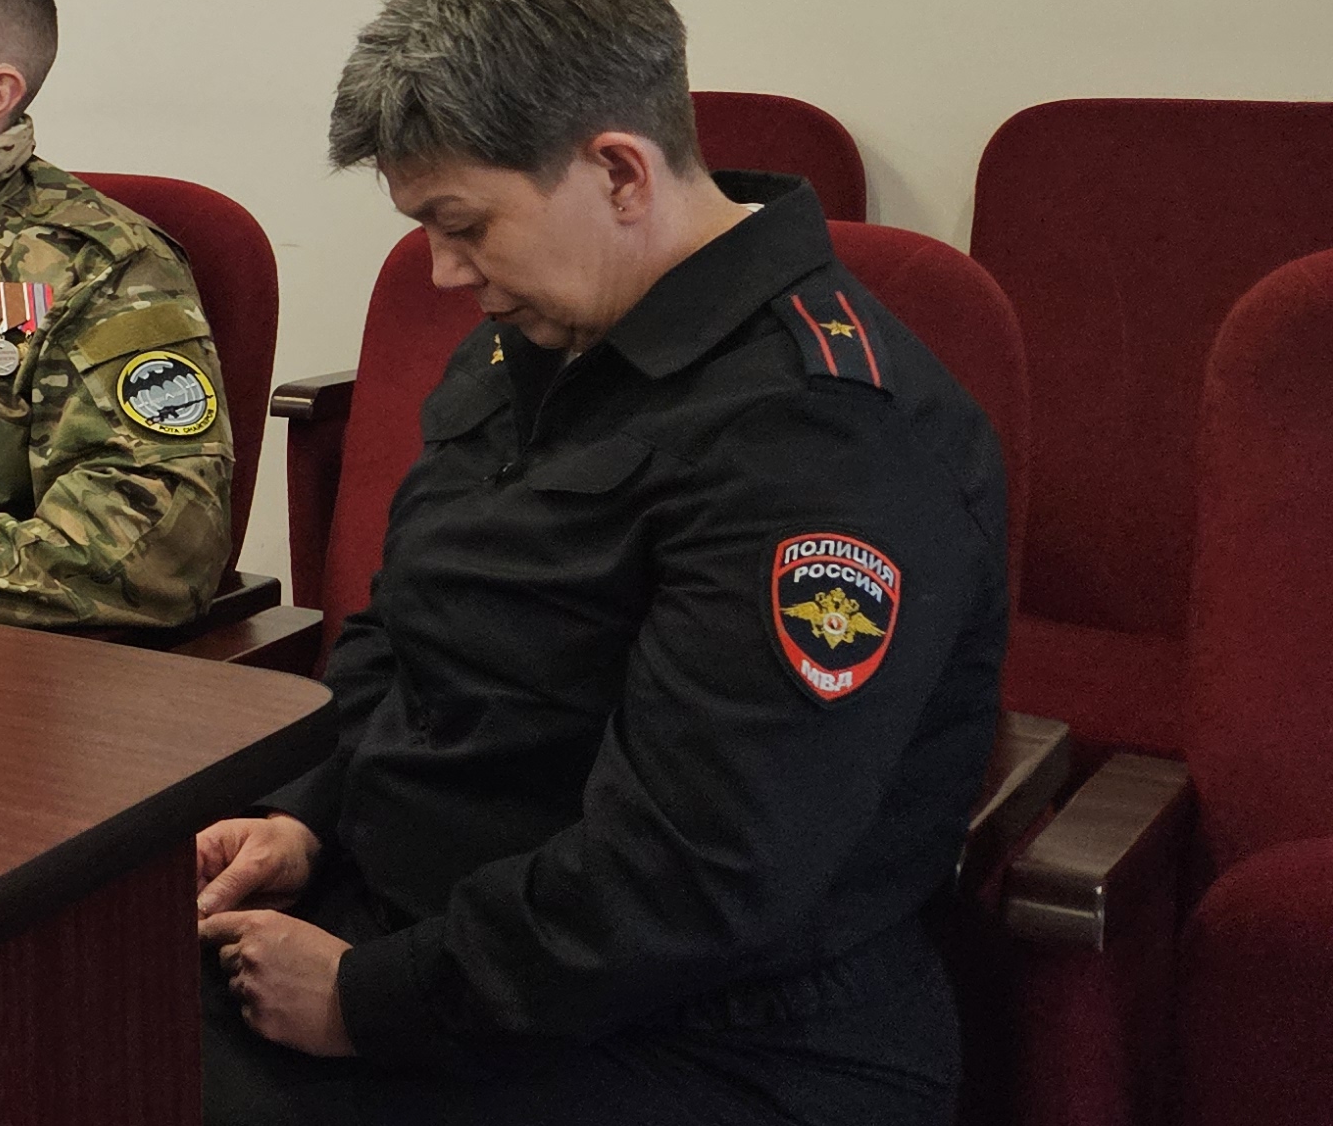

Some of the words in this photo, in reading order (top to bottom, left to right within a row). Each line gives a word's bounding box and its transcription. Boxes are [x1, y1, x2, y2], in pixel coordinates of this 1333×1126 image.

[784, 540, 894, 588] ПОЛИЦИЯ
[794, 563, 883, 604] РОССИЯ
[800, 659, 853, 692] МВД
